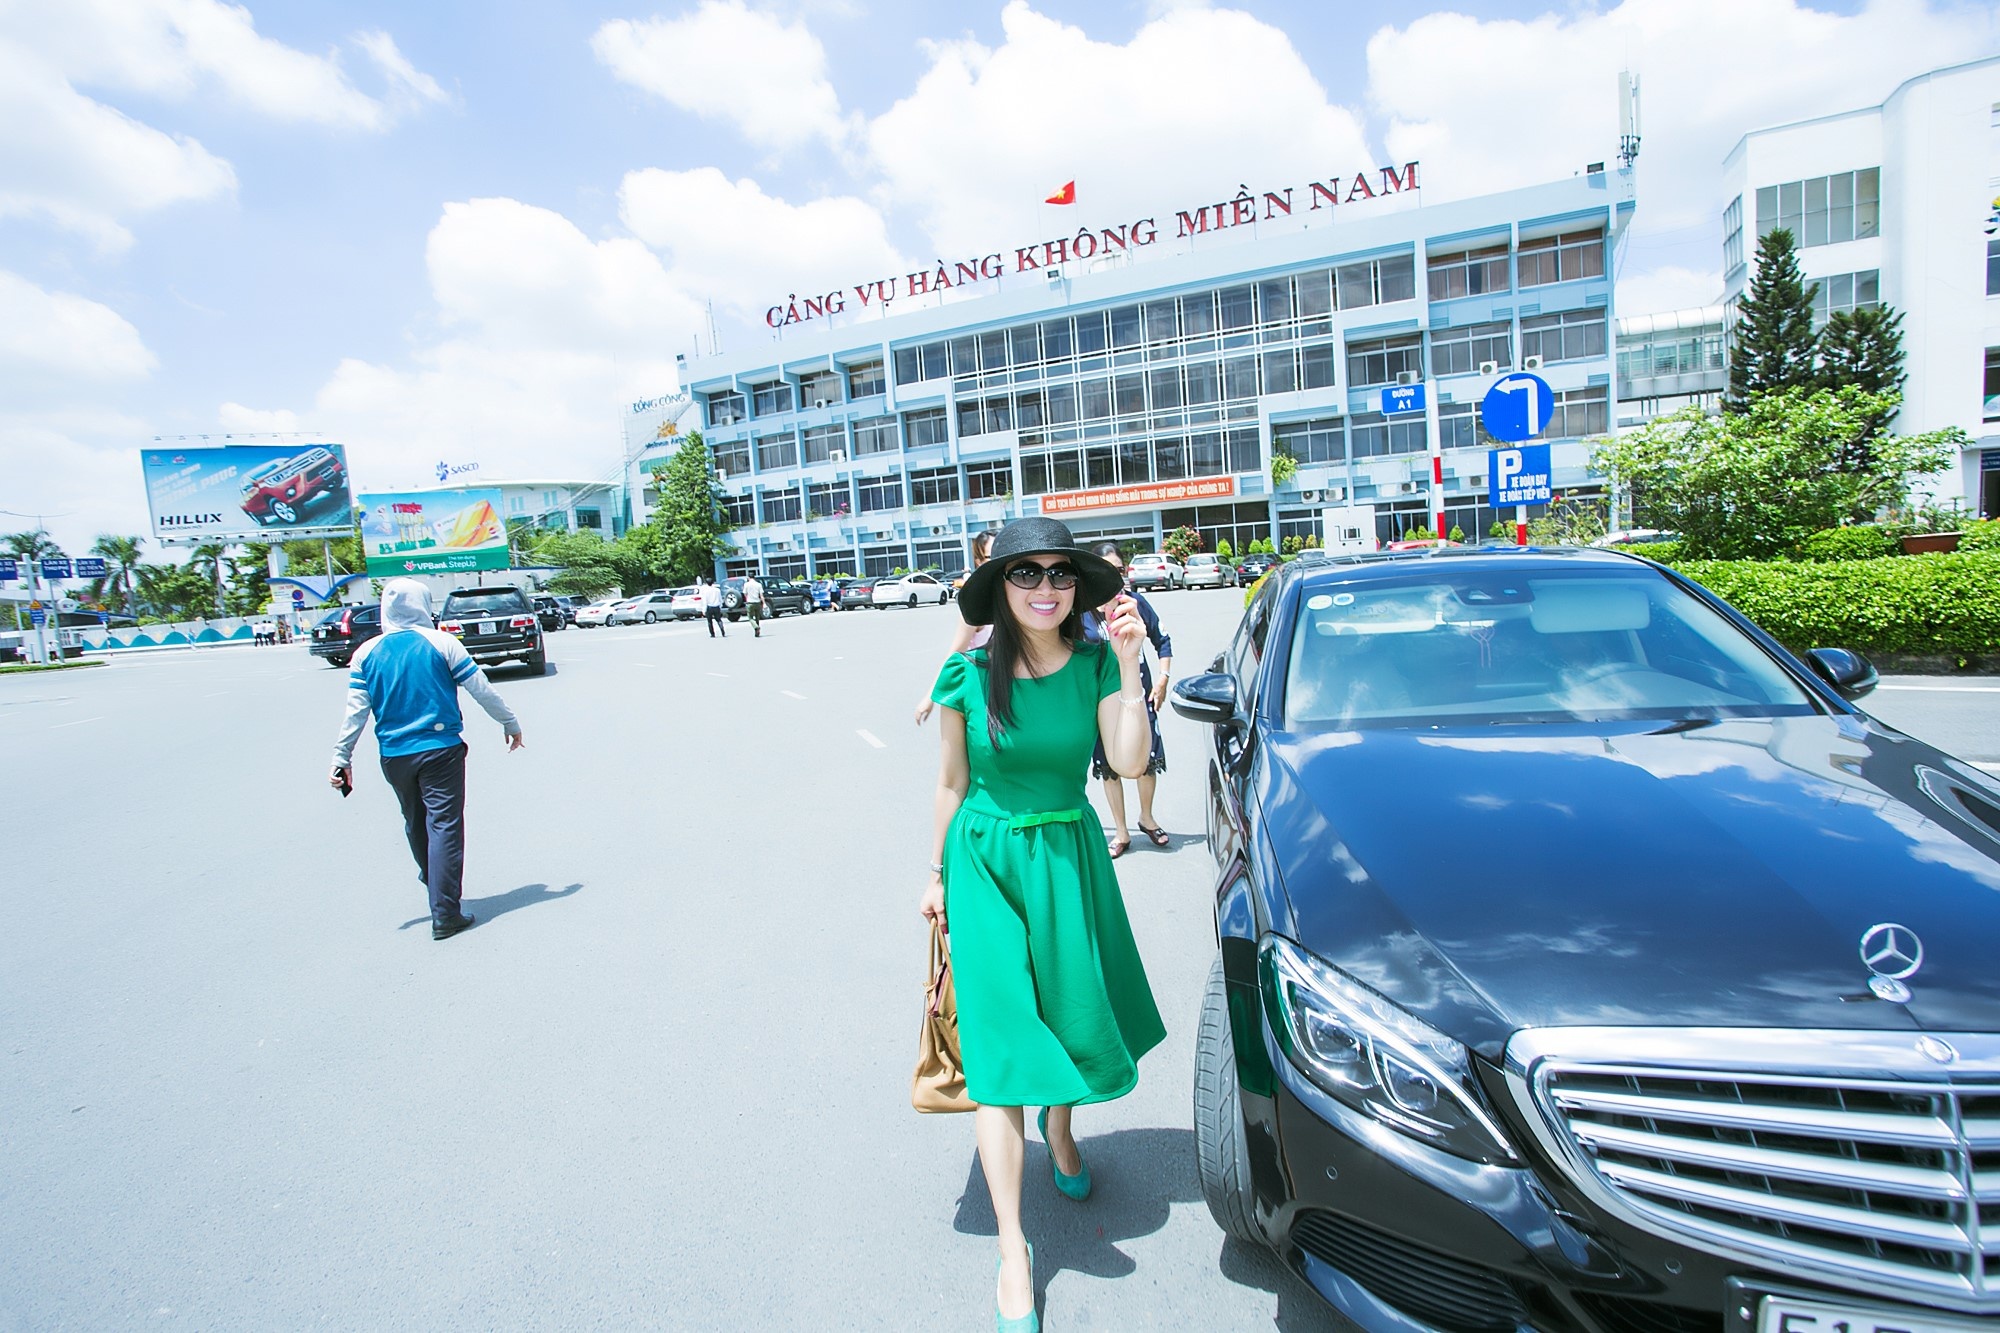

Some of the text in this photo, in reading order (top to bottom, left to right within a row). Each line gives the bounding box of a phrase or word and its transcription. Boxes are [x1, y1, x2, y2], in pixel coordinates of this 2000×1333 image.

[766, 161, 1421, 328] CẢNG VỤ HÀNG KHÔNG MIỀN NAM
[451, 462, 479, 475] SASCO
[1497, 449, 1522, 489] P
[1511, 476, 1519, 488] XE
[1140, 488, 1158, 500] TRONG
[1499, 490, 1507, 502] XE
[160, 513, 222, 526] HILUX
[417, 560, 477, 570] VPBank StepUp
